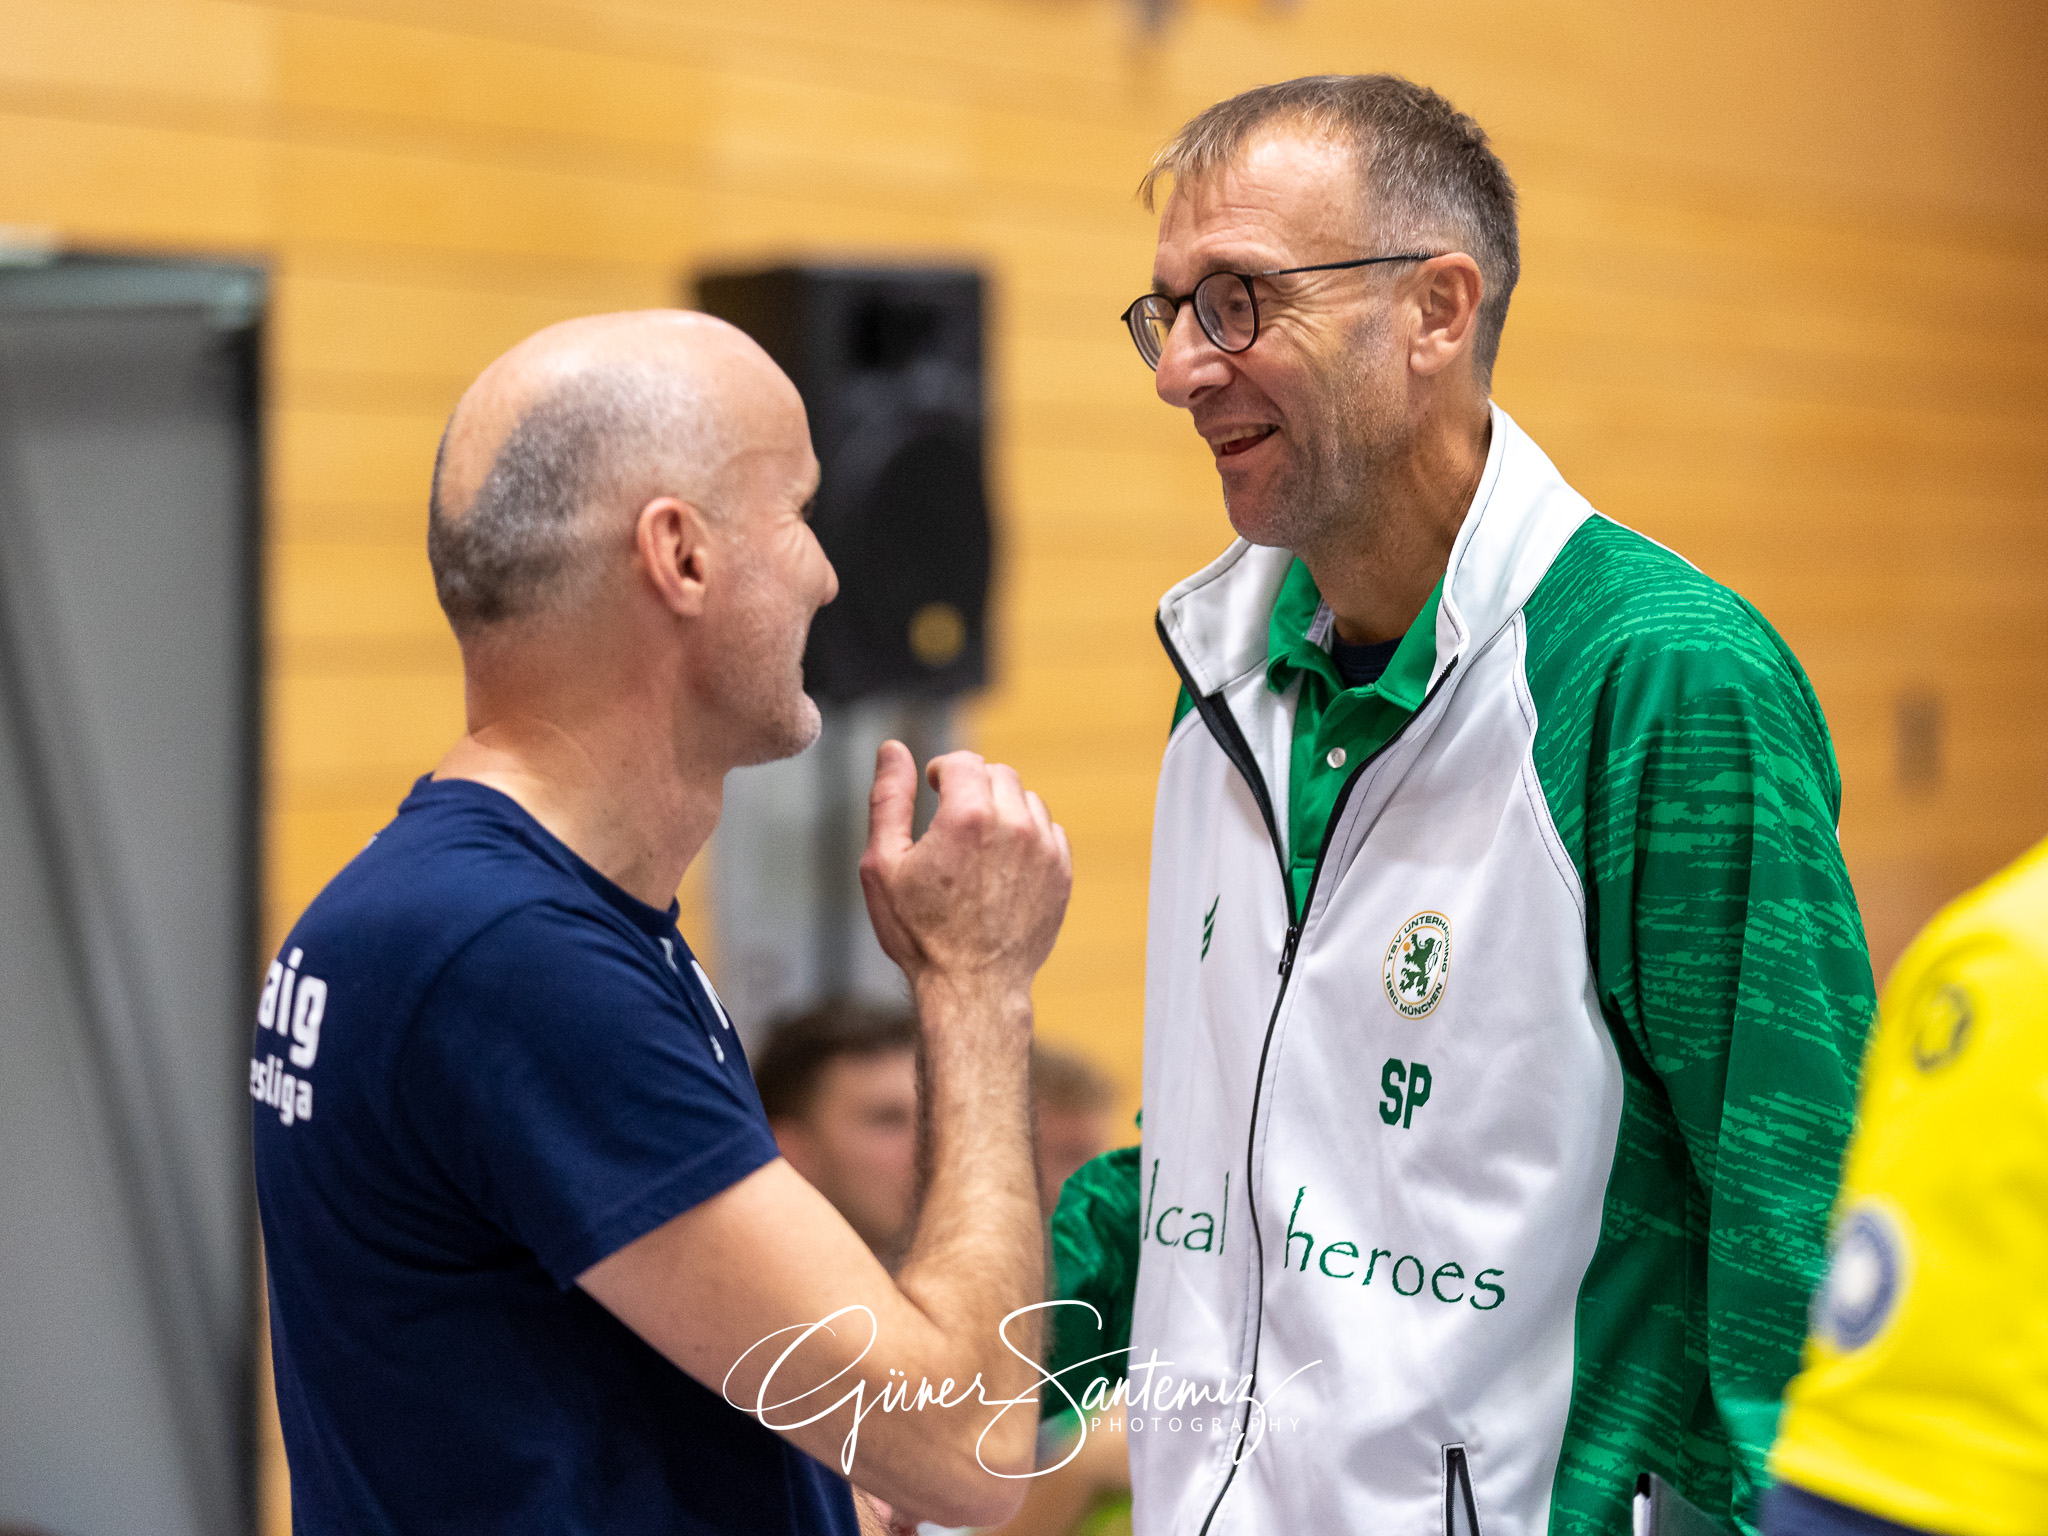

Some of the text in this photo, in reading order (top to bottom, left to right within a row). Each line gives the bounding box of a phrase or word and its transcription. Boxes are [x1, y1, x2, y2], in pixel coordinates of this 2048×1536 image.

[1386, 914, 1451, 973] TSV UNTERHACHING
[1399, 982, 1444, 1016] MÜNCHEN
[1379, 1057, 1433, 1130] SP
[1284, 1185, 1506, 1310] heroes
